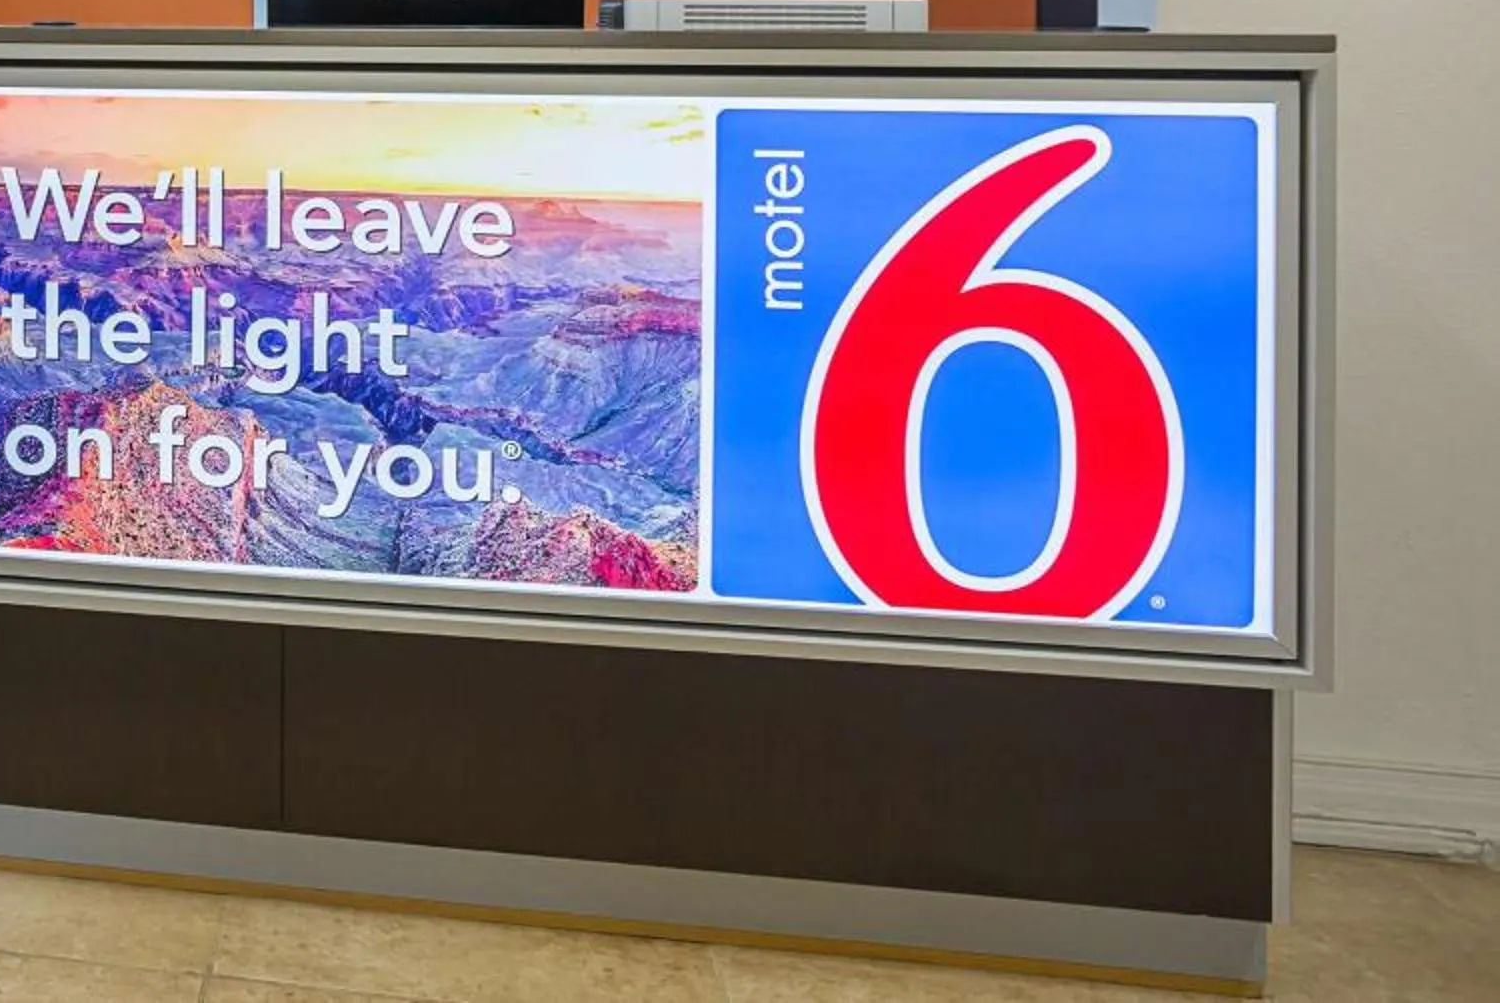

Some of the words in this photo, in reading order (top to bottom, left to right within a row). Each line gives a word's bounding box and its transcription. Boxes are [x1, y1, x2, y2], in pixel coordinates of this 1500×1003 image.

[1, 166, 224, 247] We'll
[266, 168, 515, 258] leave
[2, 283, 152, 365] the
[191, 287, 409, 394] light
[753, 149, 805, 310] motel
[800, 124, 1185, 621] 6
[4, 422, 113, 481] on
[148, 404, 288, 490] for
